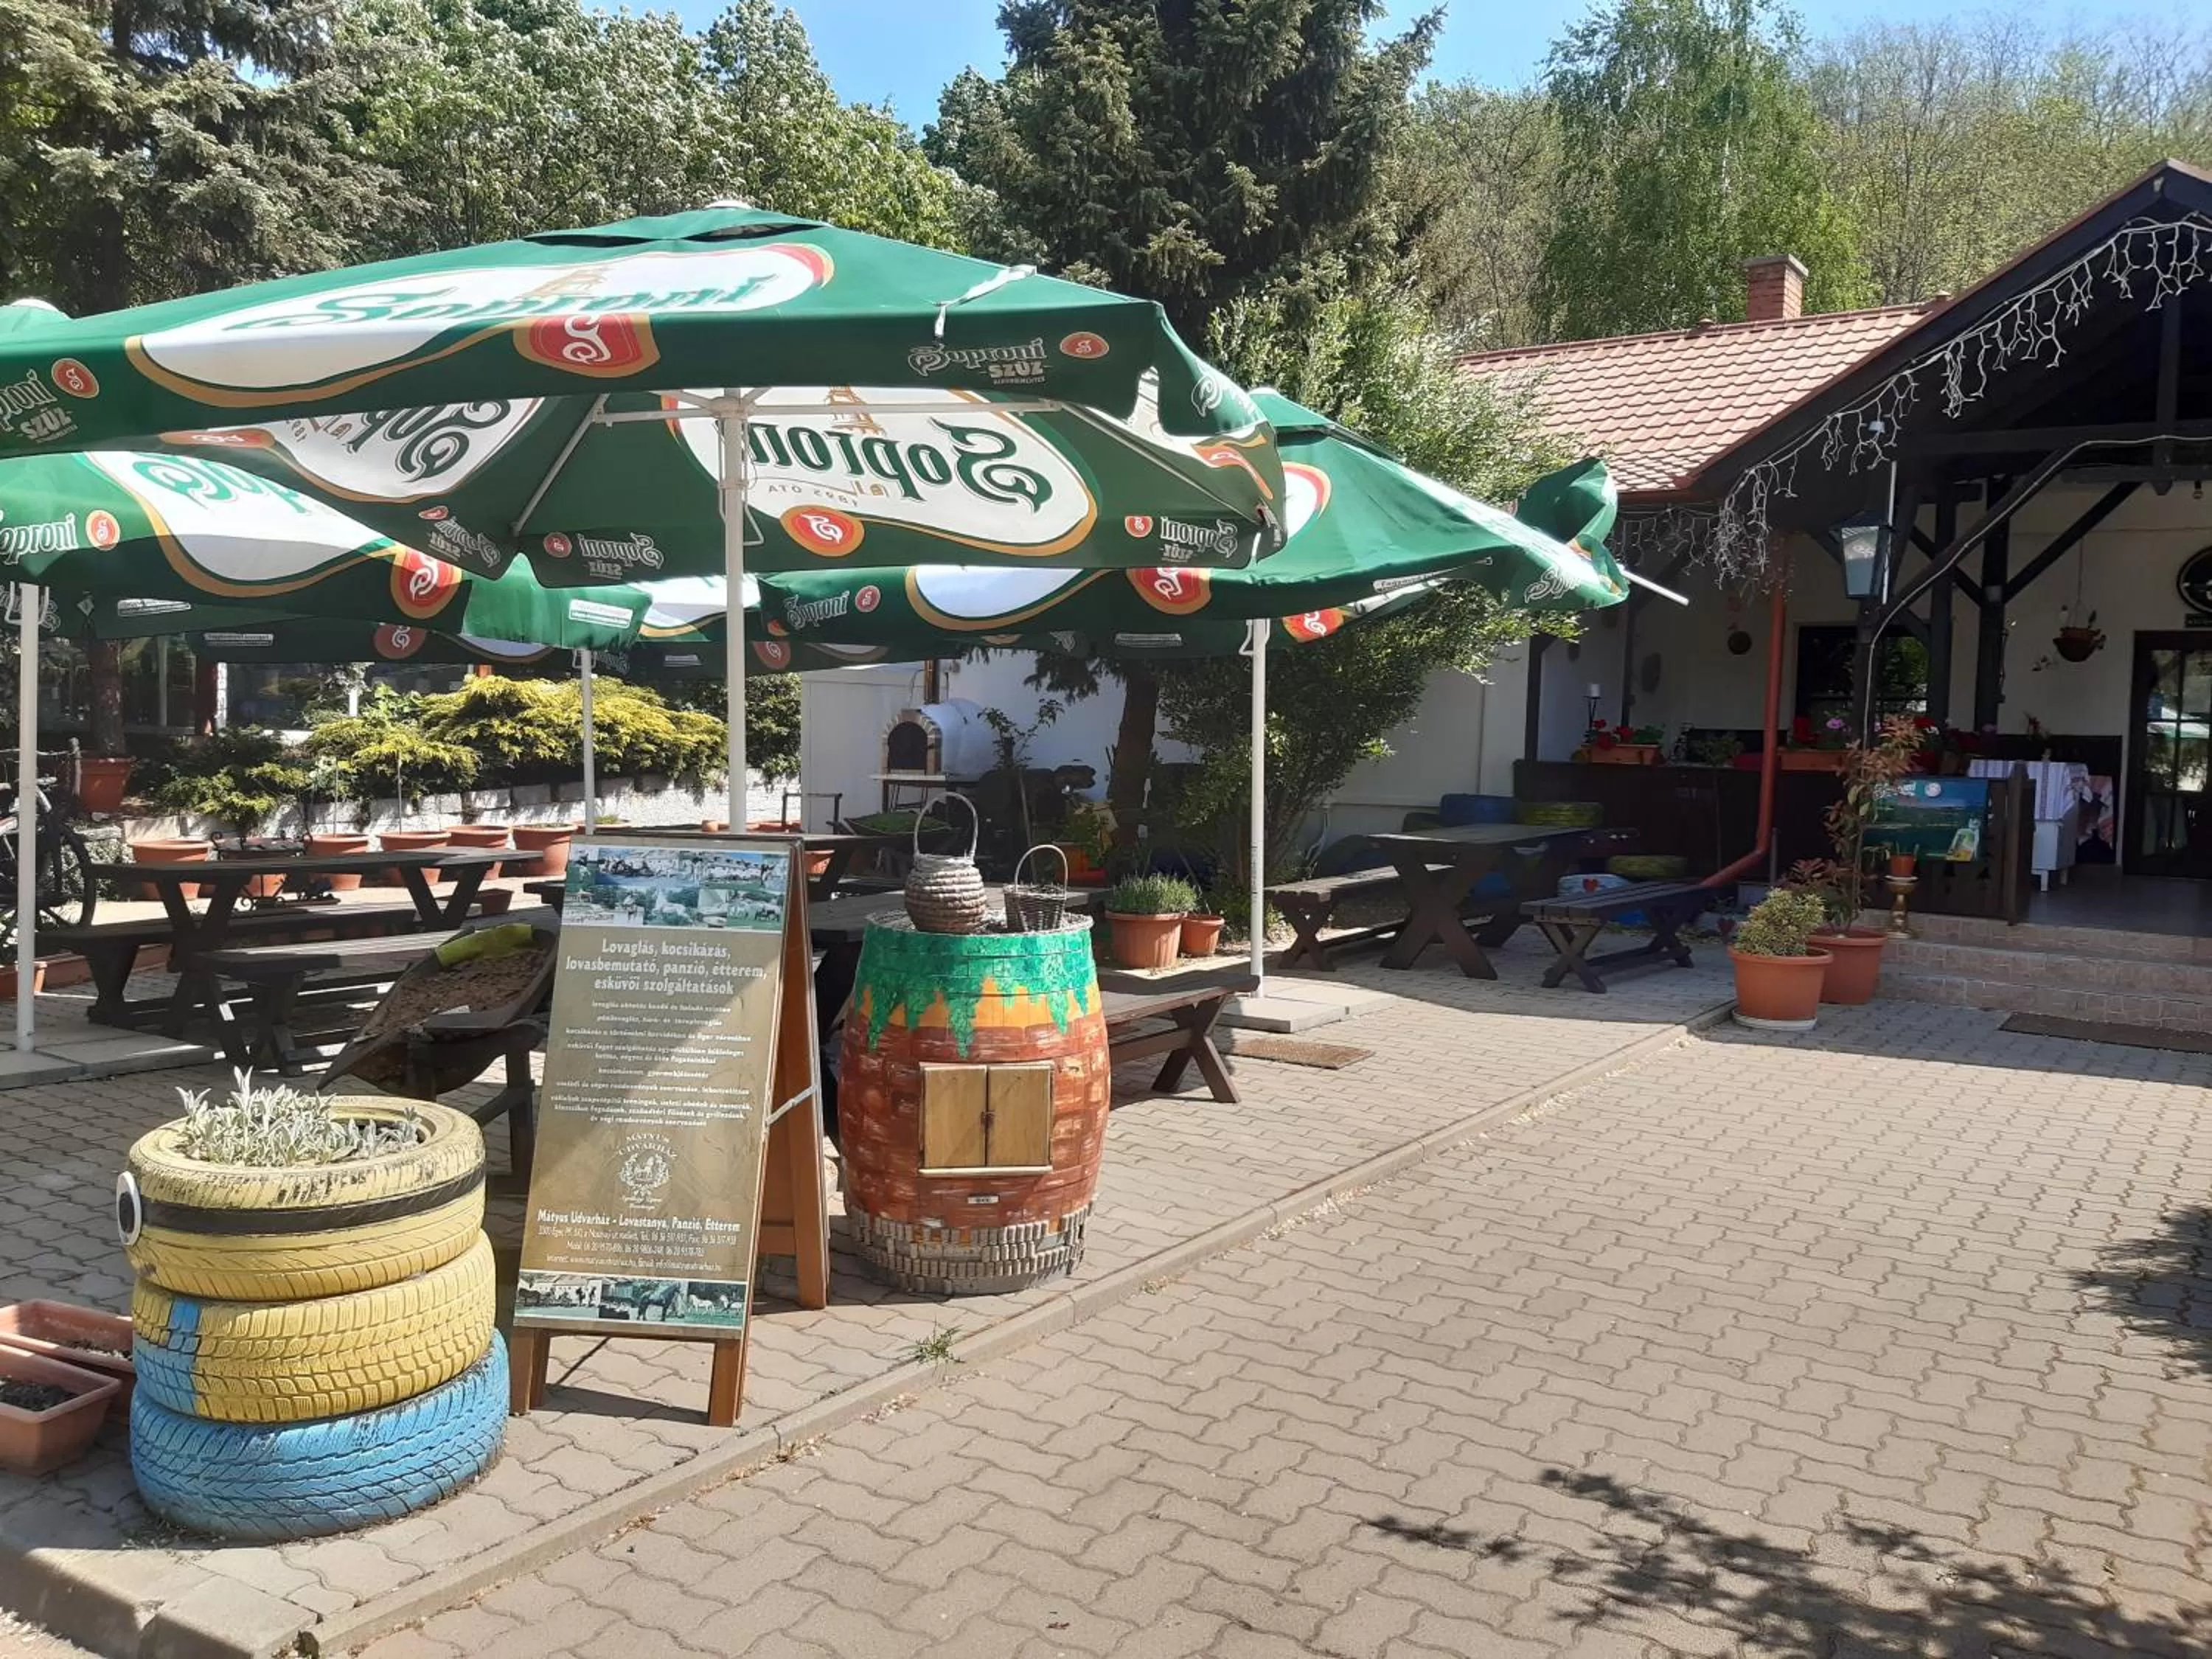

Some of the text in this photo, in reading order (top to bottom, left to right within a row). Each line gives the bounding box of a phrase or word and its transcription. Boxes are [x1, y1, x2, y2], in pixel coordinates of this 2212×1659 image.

[908, 337, 1048, 377] Soproni
[602, 938, 731, 959] Lovaglás, kocsikázás,
[566, 956, 767, 979] lovasbemutató, panzió, étterem,
[594, 976, 734, 995] esküvői szolgáltatások
